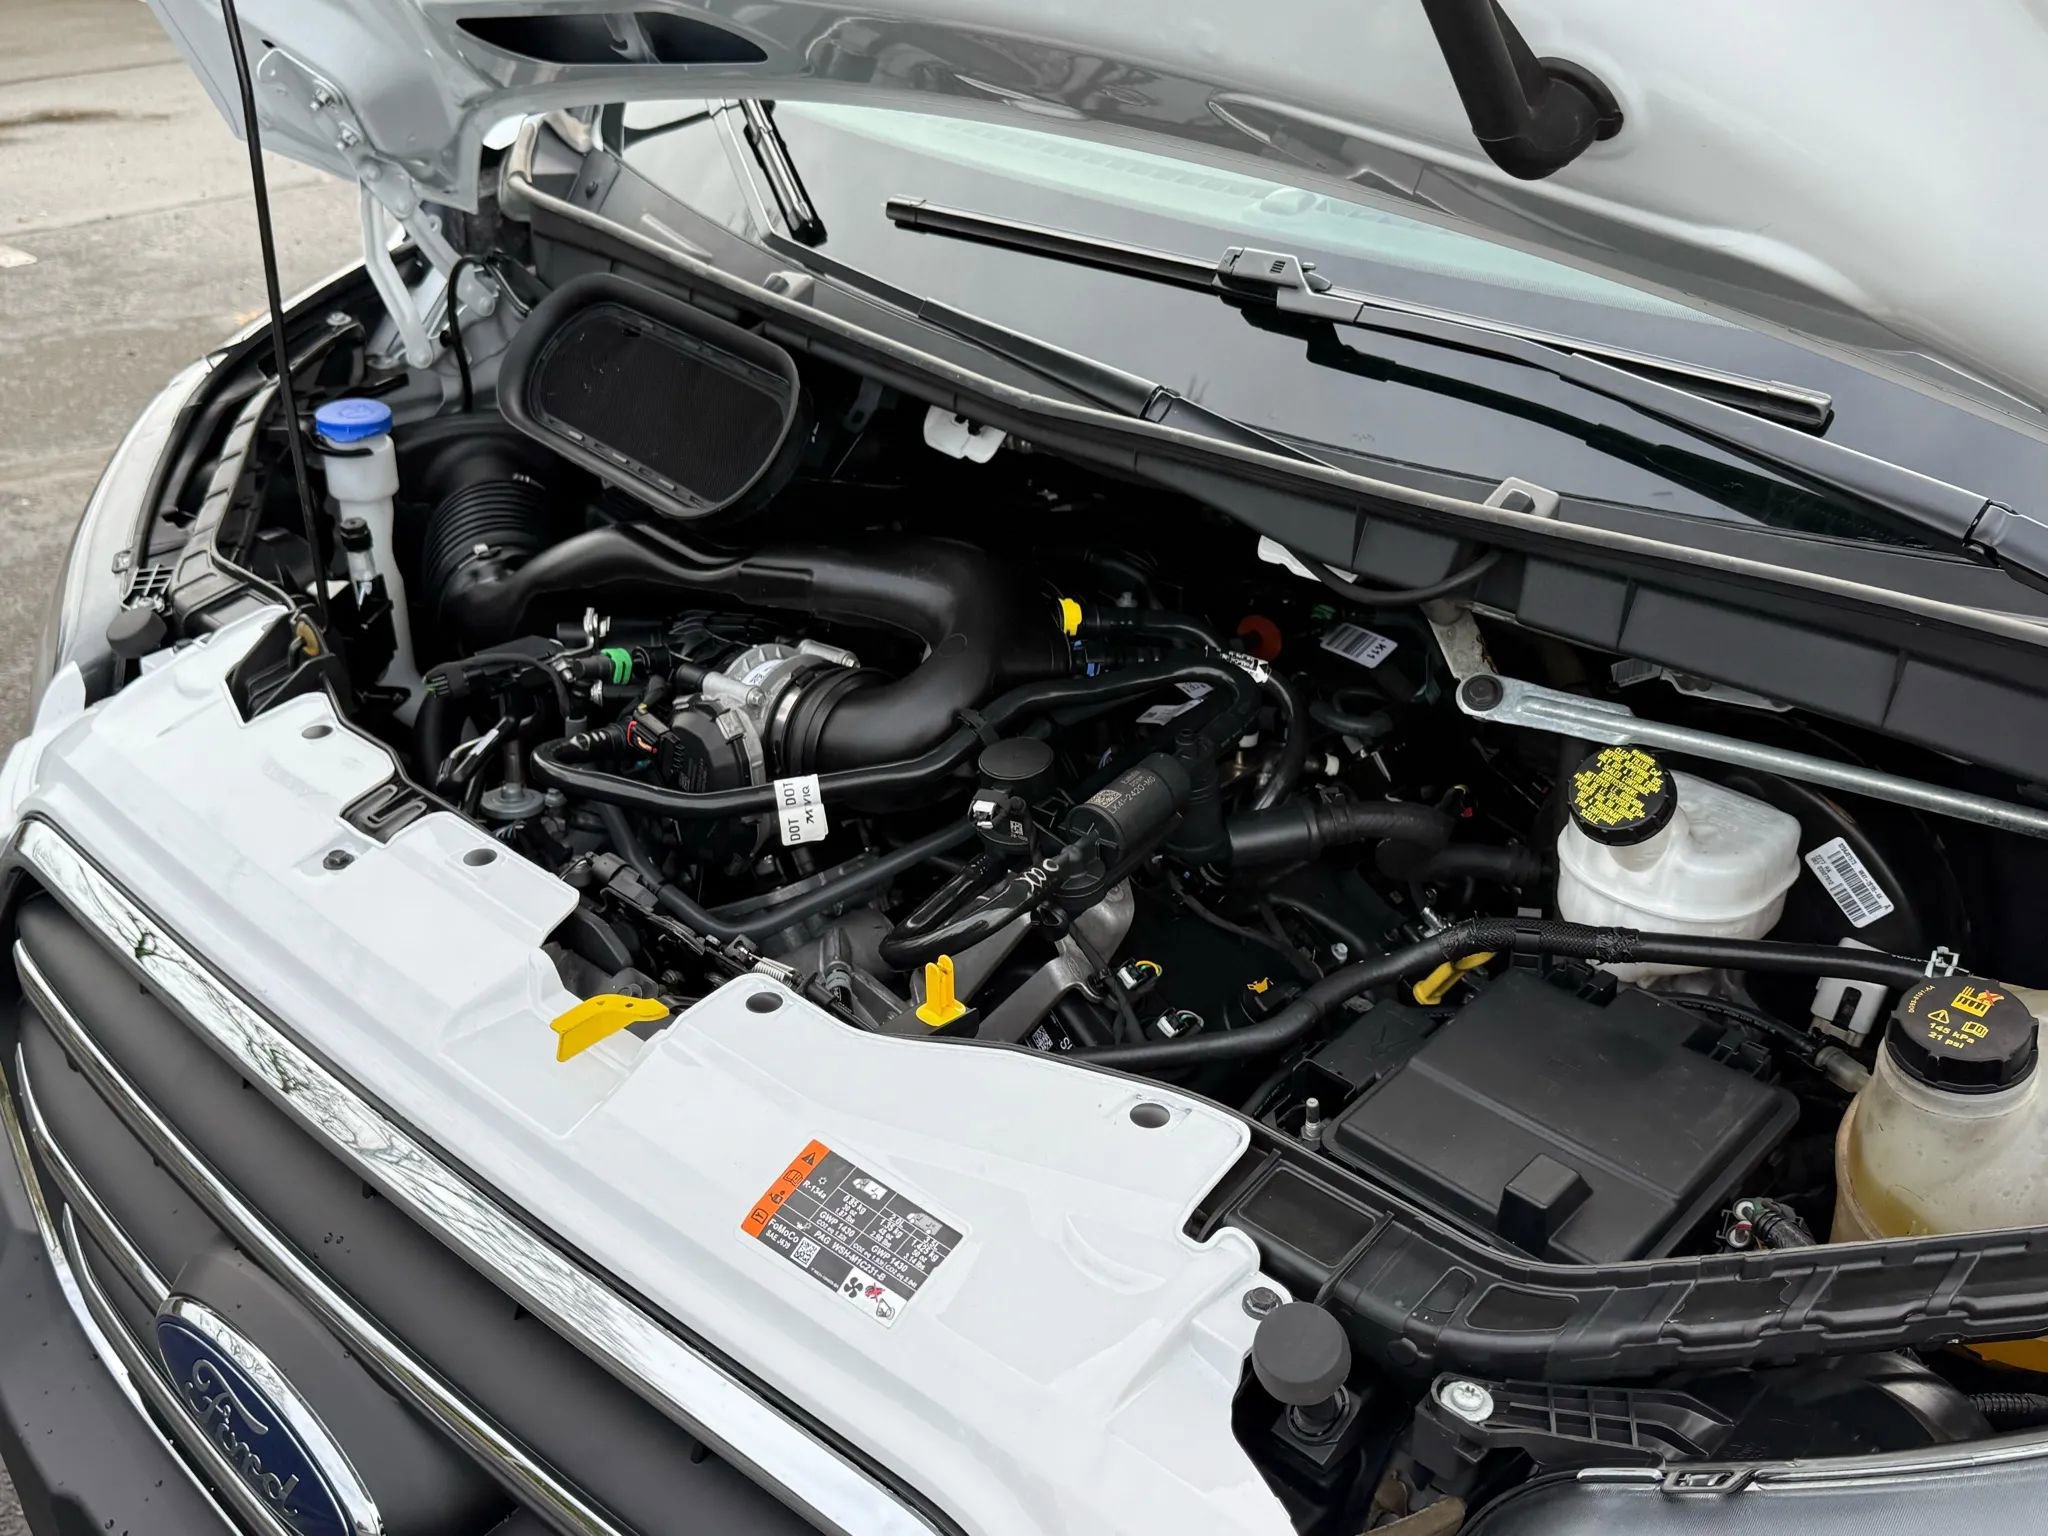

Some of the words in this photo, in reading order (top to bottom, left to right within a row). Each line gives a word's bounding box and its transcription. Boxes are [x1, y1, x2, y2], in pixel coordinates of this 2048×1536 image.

[1366, 643, 1389, 662] K11
[1601, 764, 1622, 778] SEALED
[1614, 747, 1632, 760] CLEAN
[1631, 757, 1650, 770] FILLER
[1649, 767, 1662, 778] CAP
[1643, 781, 1661, 793] FROM
[1651, 777, 1664, 787] USE
[783, 782, 797, 806] DOT
[788, 818, 801, 841] DOT
[1928, 1031, 1942, 1041] 21
[1945, 1038, 1965, 1049] psi
[1952, 1030, 1975, 1044] kPa
[802, 1179, 828, 1199] R-134a
[855, 1203, 868, 1215] kg
[767, 1218, 802, 1244] FoMoCo
[816, 1218, 829, 1229] CO2
[818, 1210, 840, 1227] GWP
[836, 1222, 857, 1238] 1430
[879, 1219, 895, 1232] 1.35
[890, 1227, 905, 1240] kg
[765, 1229, 779, 1241] SAE
[813, 1229, 833, 1245] PAG
[831, 1241, 887, 1282] WSH-M1C231-B
[852, 1242, 865, 1253] CO2
[870, 1244, 892, 1261] GWP
[889, 1256, 909, 1273] 1430
[927, 1251, 941, 1263] kg
[884, 1264, 898, 1275] CO2
[184, 1359, 300, 1517] Ford
